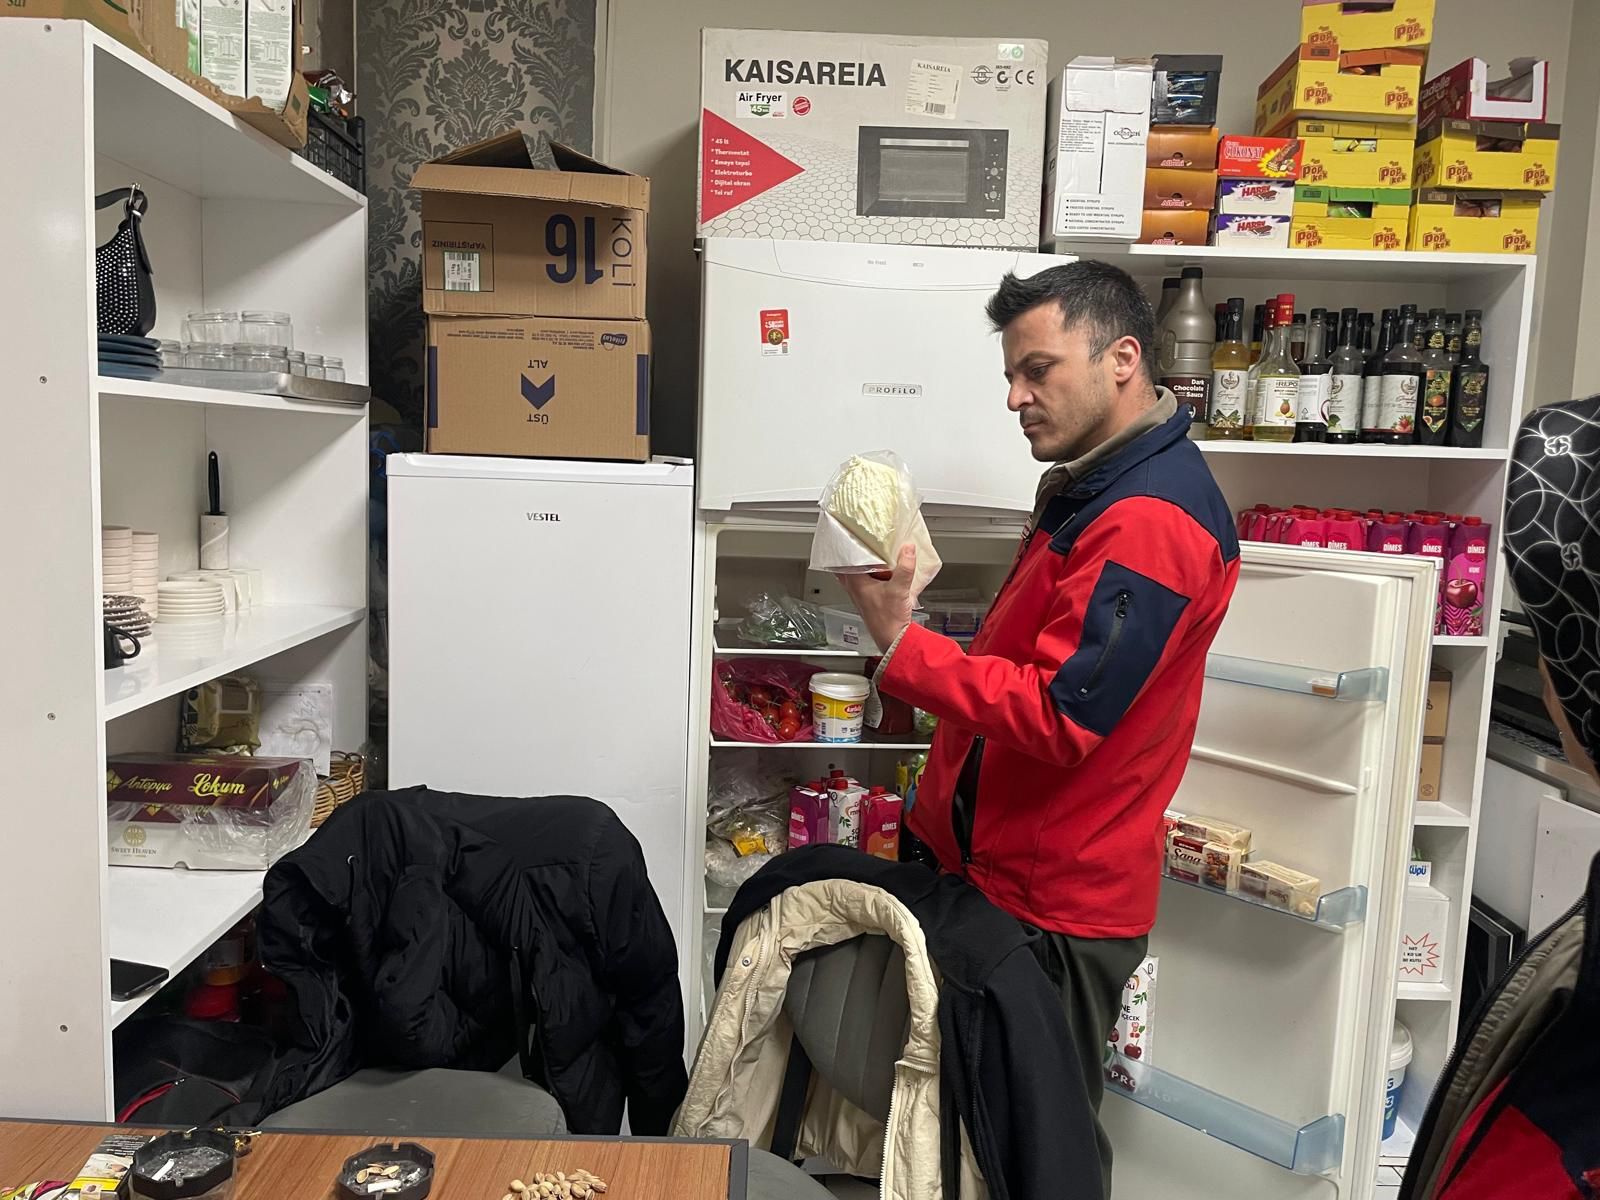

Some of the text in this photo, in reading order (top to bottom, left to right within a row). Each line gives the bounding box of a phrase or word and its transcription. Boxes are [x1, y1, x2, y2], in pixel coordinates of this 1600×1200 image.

[1395, 23, 1420, 39] Pop
[725, 59, 887, 87] KAISAREIA
[917, 62, 951, 73] KAISAREIA
[738, 93, 782, 104] Air Fryer
[1304, 86, 1328, 102] Pop
[1385, 91, 1408, 107] Pop
[752, 105, 763, 113] 45
[1302, 164, 1323, 180] Pop
[1379, 166, 1401, 182] Pop
[1446, 165, 1468, 181] Pop
[1523, 168, 1545, 184] Pop
[1295, 229, 1318, 245] Pop
[1373, 232, 1396, 248] Pop
[1423, 232, 1445, 248] Pop
[1503, 234, 1526, 250] Pop
[545, 213, 603, 285] 16
[527, 359, 549, 369] ALT
[526, 413, 550, 425] ÜST
[526, 512, 561, 522] VESTEL
[1327, 540, 1348, 550] DİMES
[1383, 542, 1402, 552] DİMES
[1422, 543, 1442, 553] DİMES
[1467, 544, 1485, 554] DİMES
[126, 775, 173, 795] Antepya
[187, 773, 246, 797] Lokum
[1173, 848, 1201, 866] Sana
